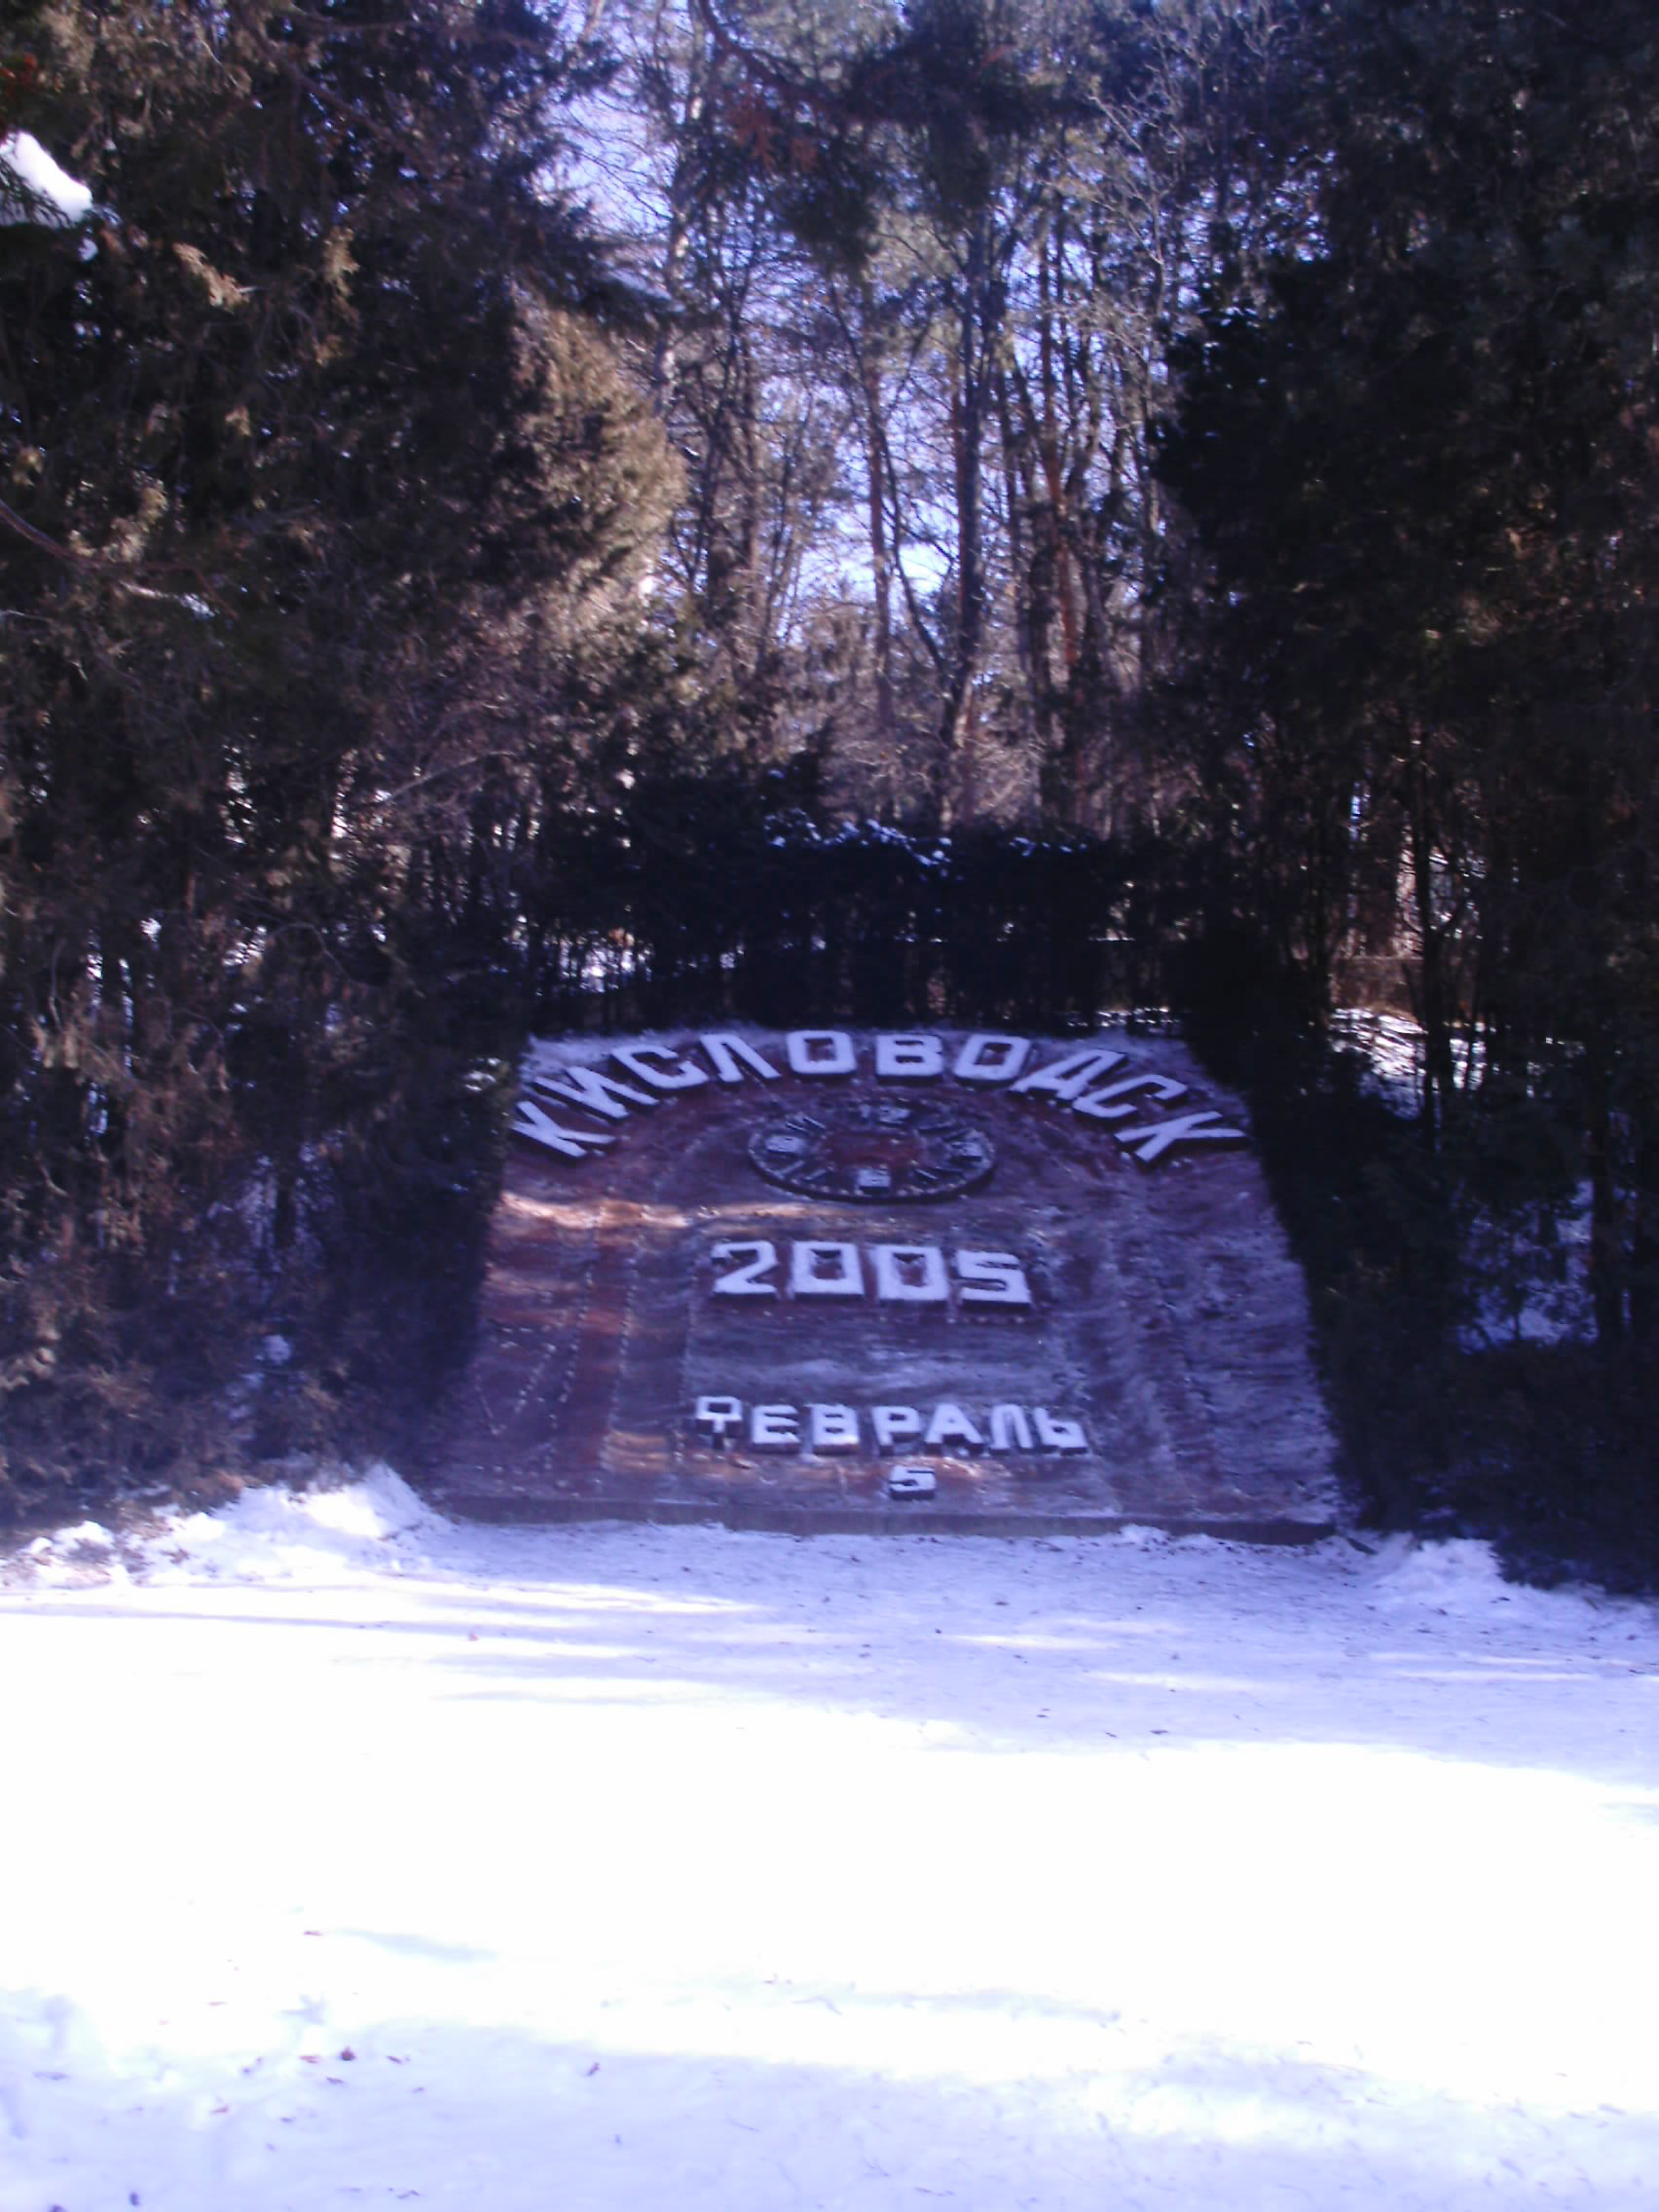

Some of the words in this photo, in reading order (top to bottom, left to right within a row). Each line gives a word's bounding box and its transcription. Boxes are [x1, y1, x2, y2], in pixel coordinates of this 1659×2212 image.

[510, 1030, 1247, 1161] КИСЛОВОДСК
[710, 1240, 1030, 1306] 2005
[695, 1395, 1088, 1455] ФЕВРАЛЬ
[889, 1465, 937, 1499] 5
